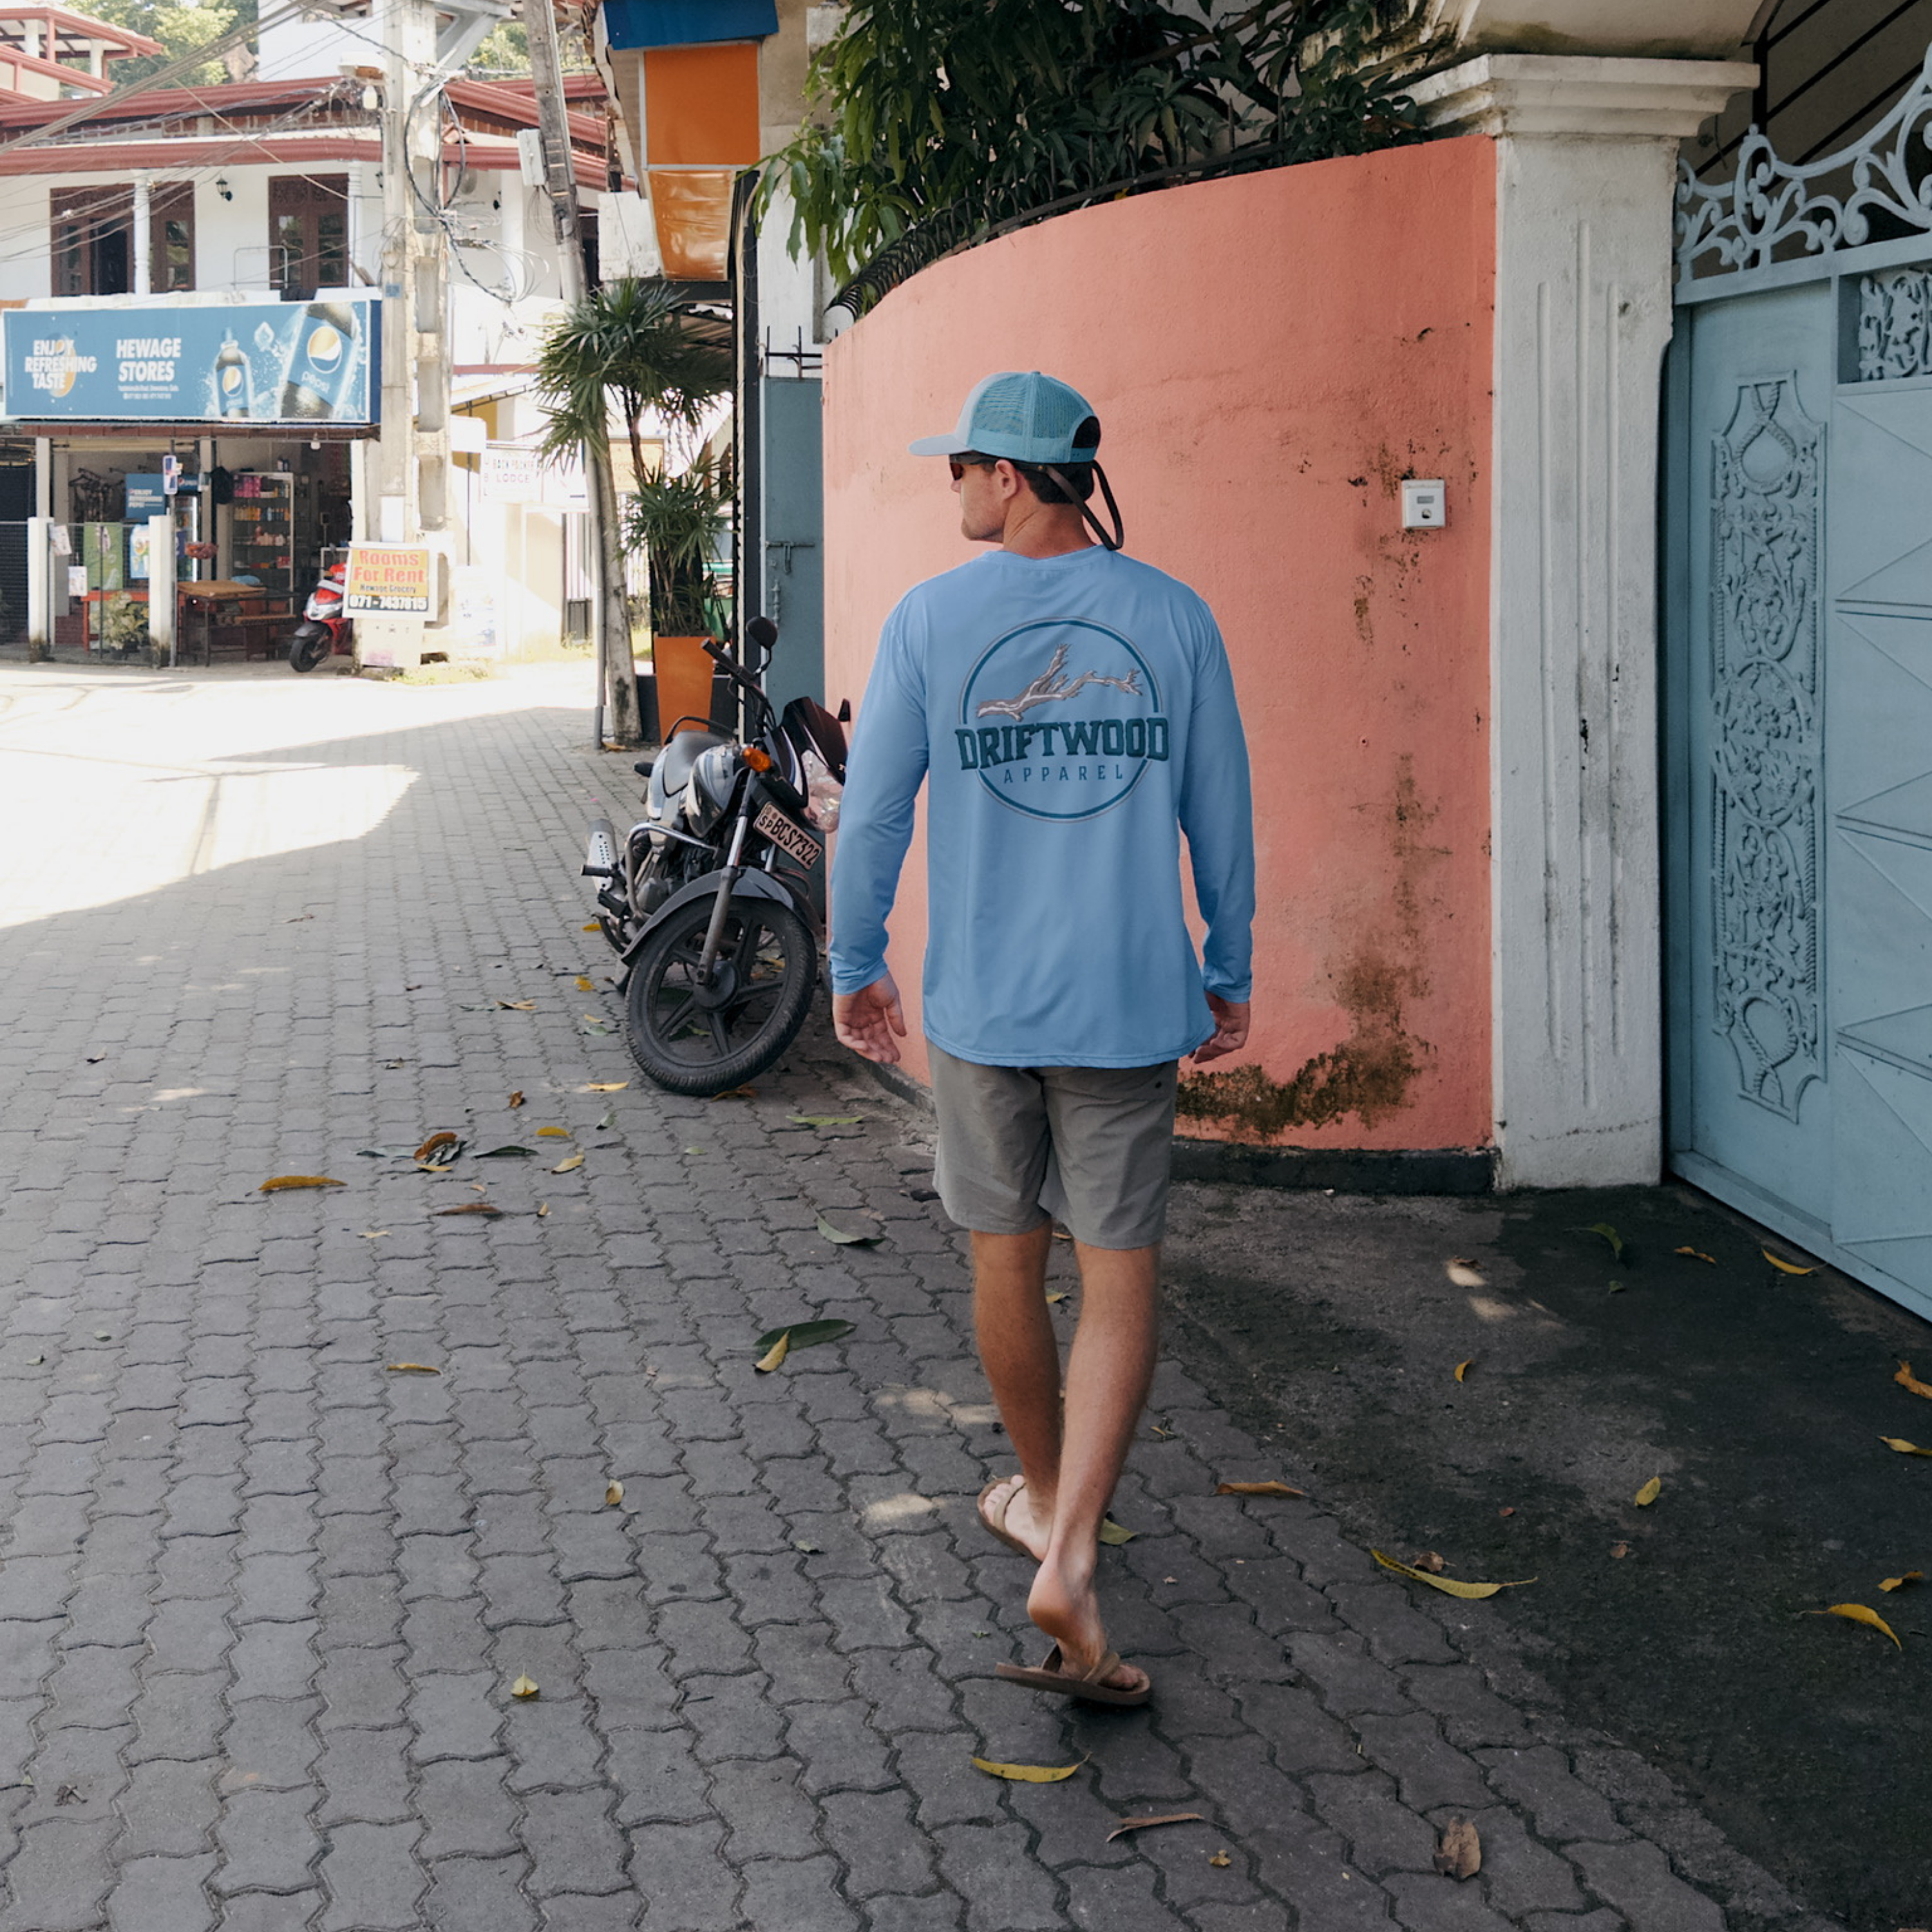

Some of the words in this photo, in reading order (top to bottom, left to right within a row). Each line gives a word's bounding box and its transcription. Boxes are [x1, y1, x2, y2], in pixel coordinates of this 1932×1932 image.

[33, 339, 75, 355] ENJOY
[117, 337, 182, 359] HEWAGE
[24, 356, 97, 372] REFRESHING
[118, 360, 175, 382] STORES
[32, 373, 66, 389] TASTE
[301, 371, 330, 393] pepsi
[497, 473, 531, 484] LODGE
[359, 551, 419, 566] Rooms
[354, 567, 379, 582] For
[384, 567, 424, 583] Rent
[389, 585, 417, 594] Grocery
[954, 717, 1170, 771] DRIFTWOOD
[1003, 764, 1122, 784] APPAREL
[759, 815, 773, 829] SP
